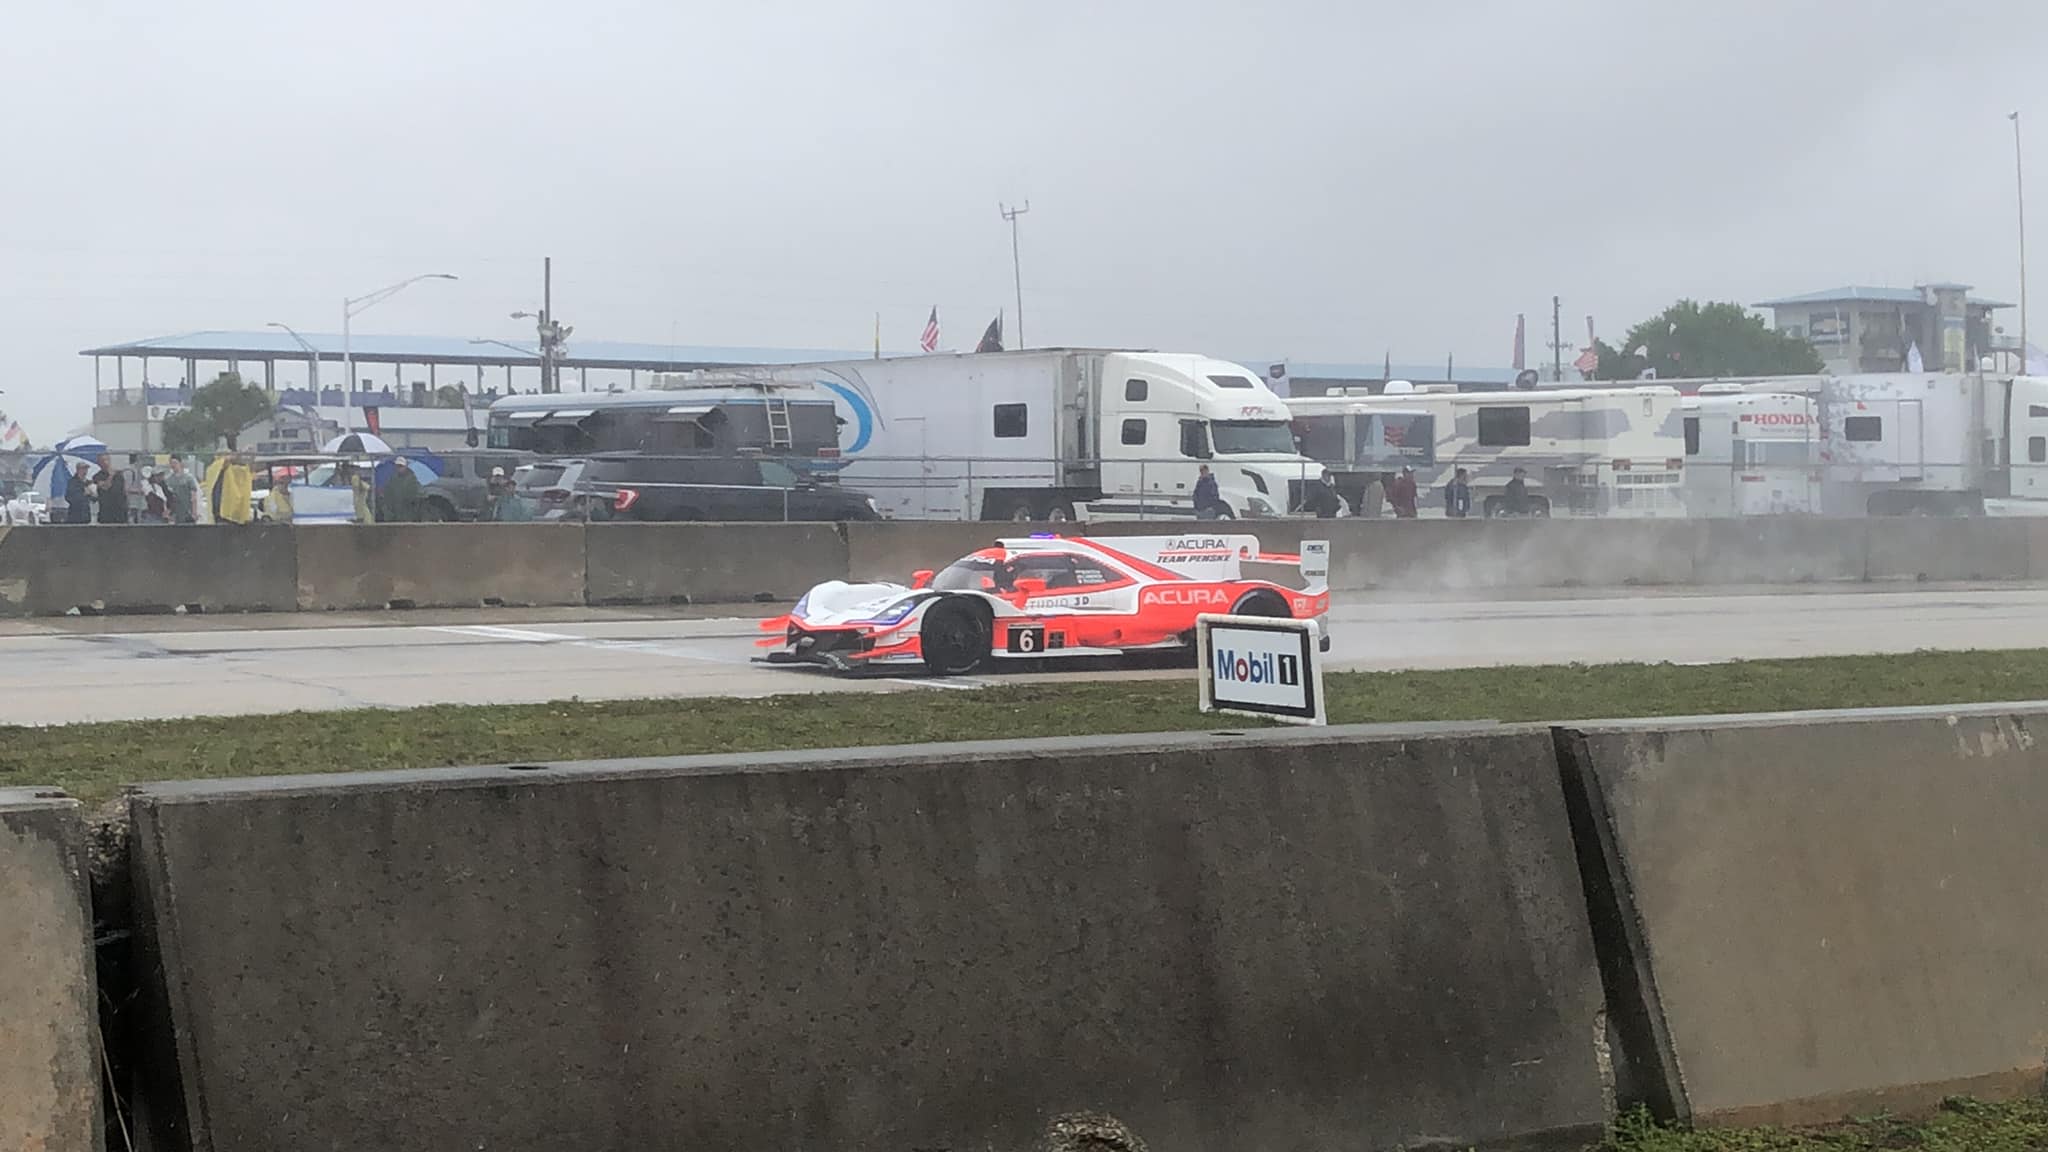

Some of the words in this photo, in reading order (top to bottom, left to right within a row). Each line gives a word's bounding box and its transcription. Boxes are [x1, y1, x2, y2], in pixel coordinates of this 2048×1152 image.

[1753, 414, 1815, 425] HONDA
[1176, 539, 1225, 550] ACURA
[1156, 555, 1187, 564] TEAM
[1189, 554, 1232, 563] PENSKE
[1144, 589, 1229, 605] ACURA
[1027, 599, 1069, 609] TUDIO
[1019, 629, 1034, 652] 6
[1217, 649, 1274, 684] Mobil
